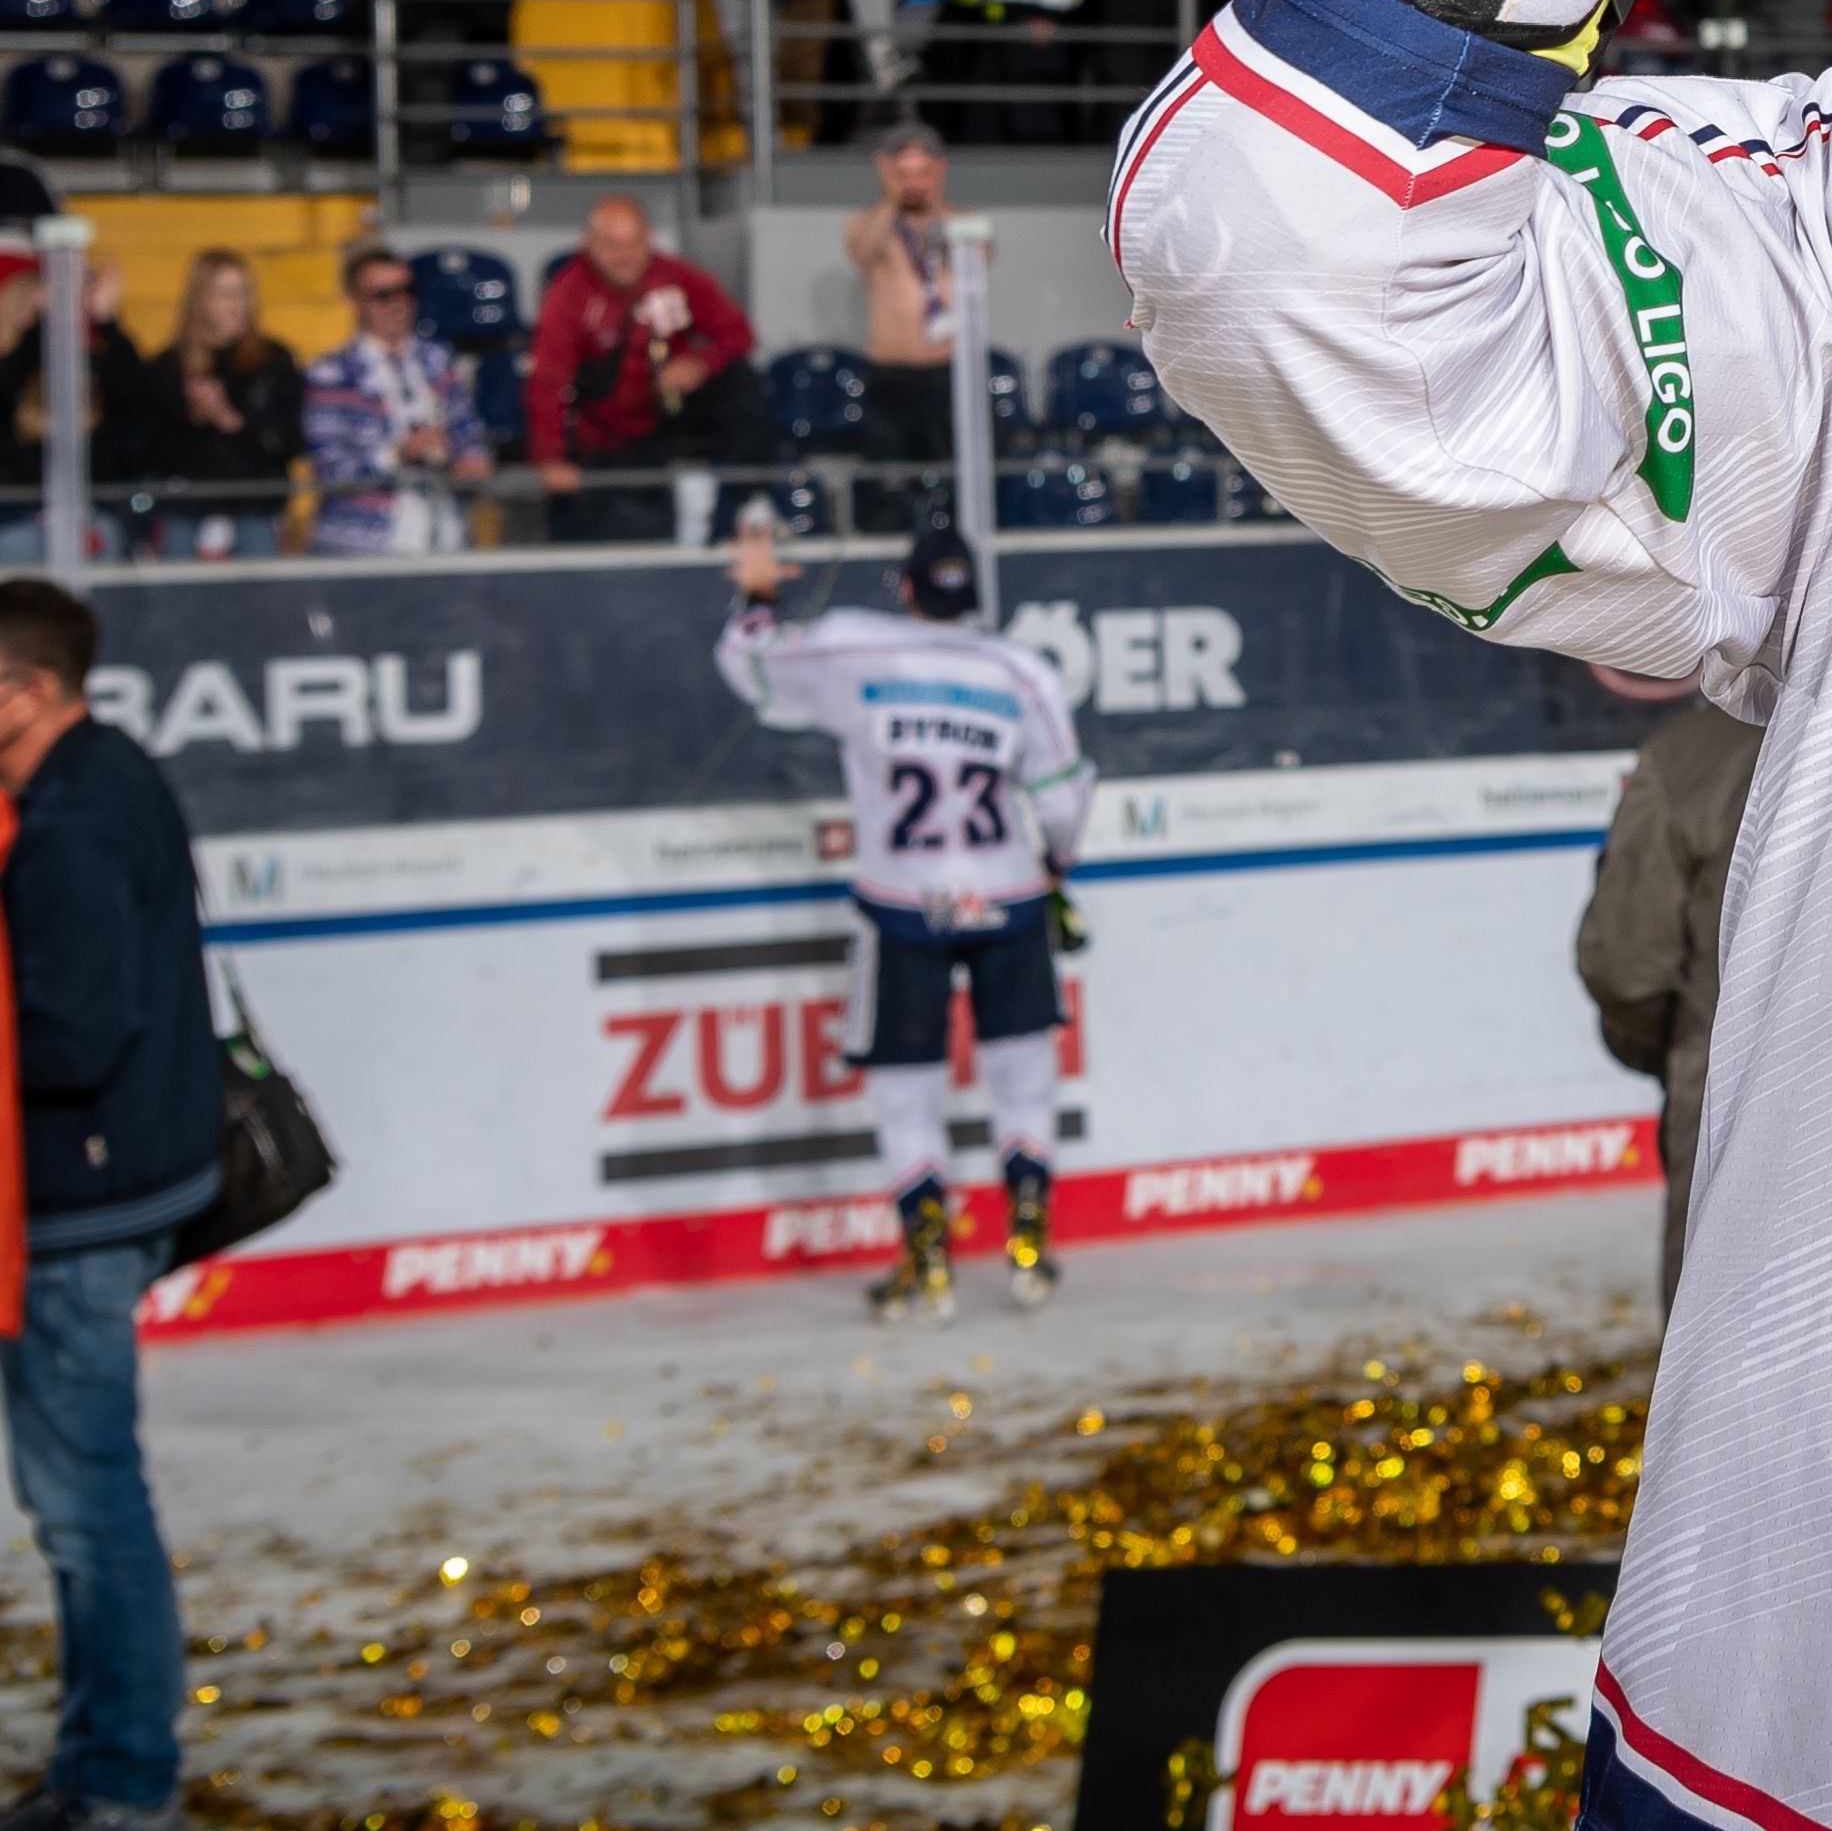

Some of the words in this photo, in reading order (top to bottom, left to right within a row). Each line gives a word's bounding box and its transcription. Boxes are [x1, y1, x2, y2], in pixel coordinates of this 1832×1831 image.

[1636, 302, 1693, 454] LIGO
[85, 649, 482, 758] BARU
[1002, 599, 1247, 715] ÖER
[889, 759, 1006, 853] 23
